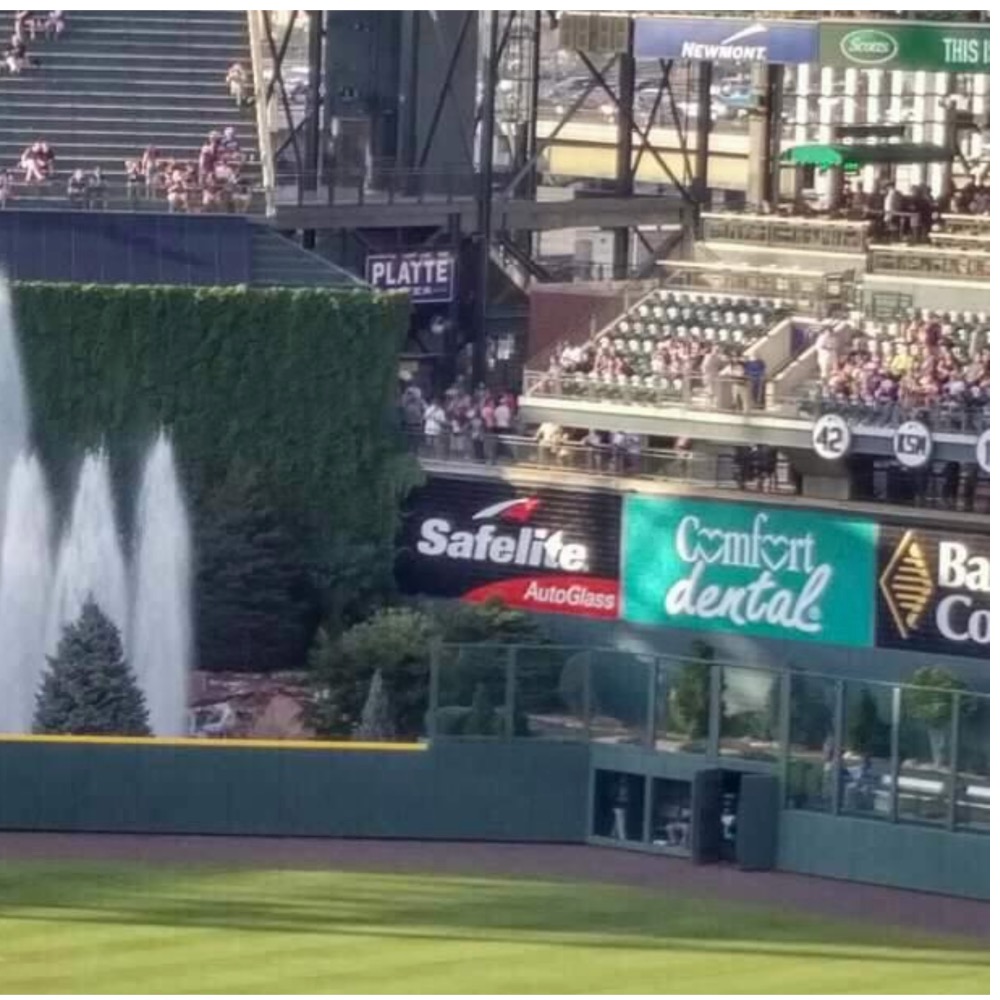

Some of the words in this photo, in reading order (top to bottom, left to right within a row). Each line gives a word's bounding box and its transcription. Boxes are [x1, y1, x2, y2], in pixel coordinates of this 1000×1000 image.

[682, 41, 767, 59] NEWMONT
[943, 38, 979, 64] THIS
[983, 41, 990, 65] I
[372, 260, 448, 286] PLATTE
[816, 426, 844, 454] 42
[416, 518, 590, 572] Safelite
[938, 541, 990, 592] Ba
[523, 581, 616, 611] AutoGlass
[665, 561, 833, 632] dental
[936, 594, 990, 644] Co
